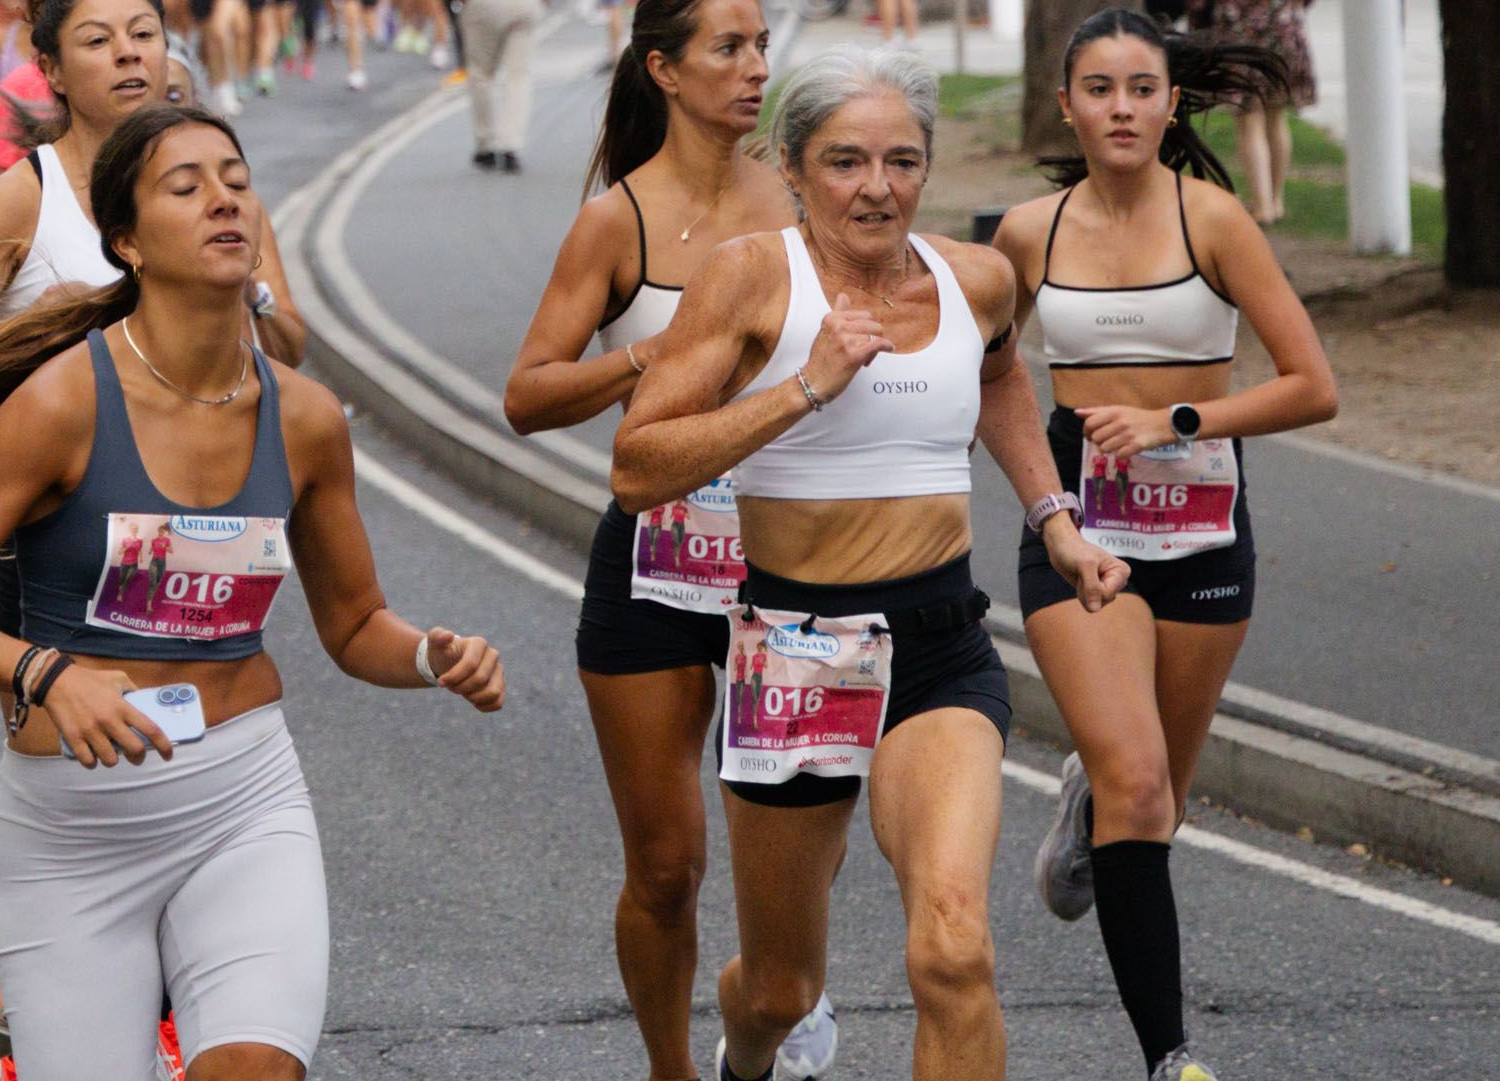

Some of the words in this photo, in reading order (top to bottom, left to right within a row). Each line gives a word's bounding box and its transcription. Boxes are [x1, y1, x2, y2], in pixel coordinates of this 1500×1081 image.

[1095, 314, 1144, 327] OYSHO
[873, 380, 928, 395] OYSHO
[1132, 484, 1189, 507] 016
[176, 515, 241, 532] ASTURIANA
[688, 535, 745, 561] 016
[1099, 535, 1145, 550] OYSHO
[686, 573, 697, 583] DE
[698, 575, 709, 584] LA
[711, 576, 738, 587] MUJER
[165, 572, 234, 604] 016
[651, 587, 702, 601] OYSHO
[1192, 585, 1240, 600] OYSHO
[179, 608, 213, 623] 1254
[109, 611, 153, 630] CARRERA
[155, 621, 168, 632] DE
[170, 623, 183, 634] LA
[185, 625, 215, 637] MUJER
[219, 625, 225, 636] A
[225, 620, 251, 634] CORUÑA
[772, 631, 834, 653] ASTURIANA
[765, 687, 825, 716] 016
[738, 735, 760, 746] CARRERA
[761, 737, 772, 747] DE
[773, 737, 784, 749] LA
[785, 734, 810, 748] MUJER
[814, 733, 821, 744] A
[822, 731, 858, 744] CORUÑA
[740, 757, 777, 772] OYSHO
[810, 755, 853, 769] Santander
